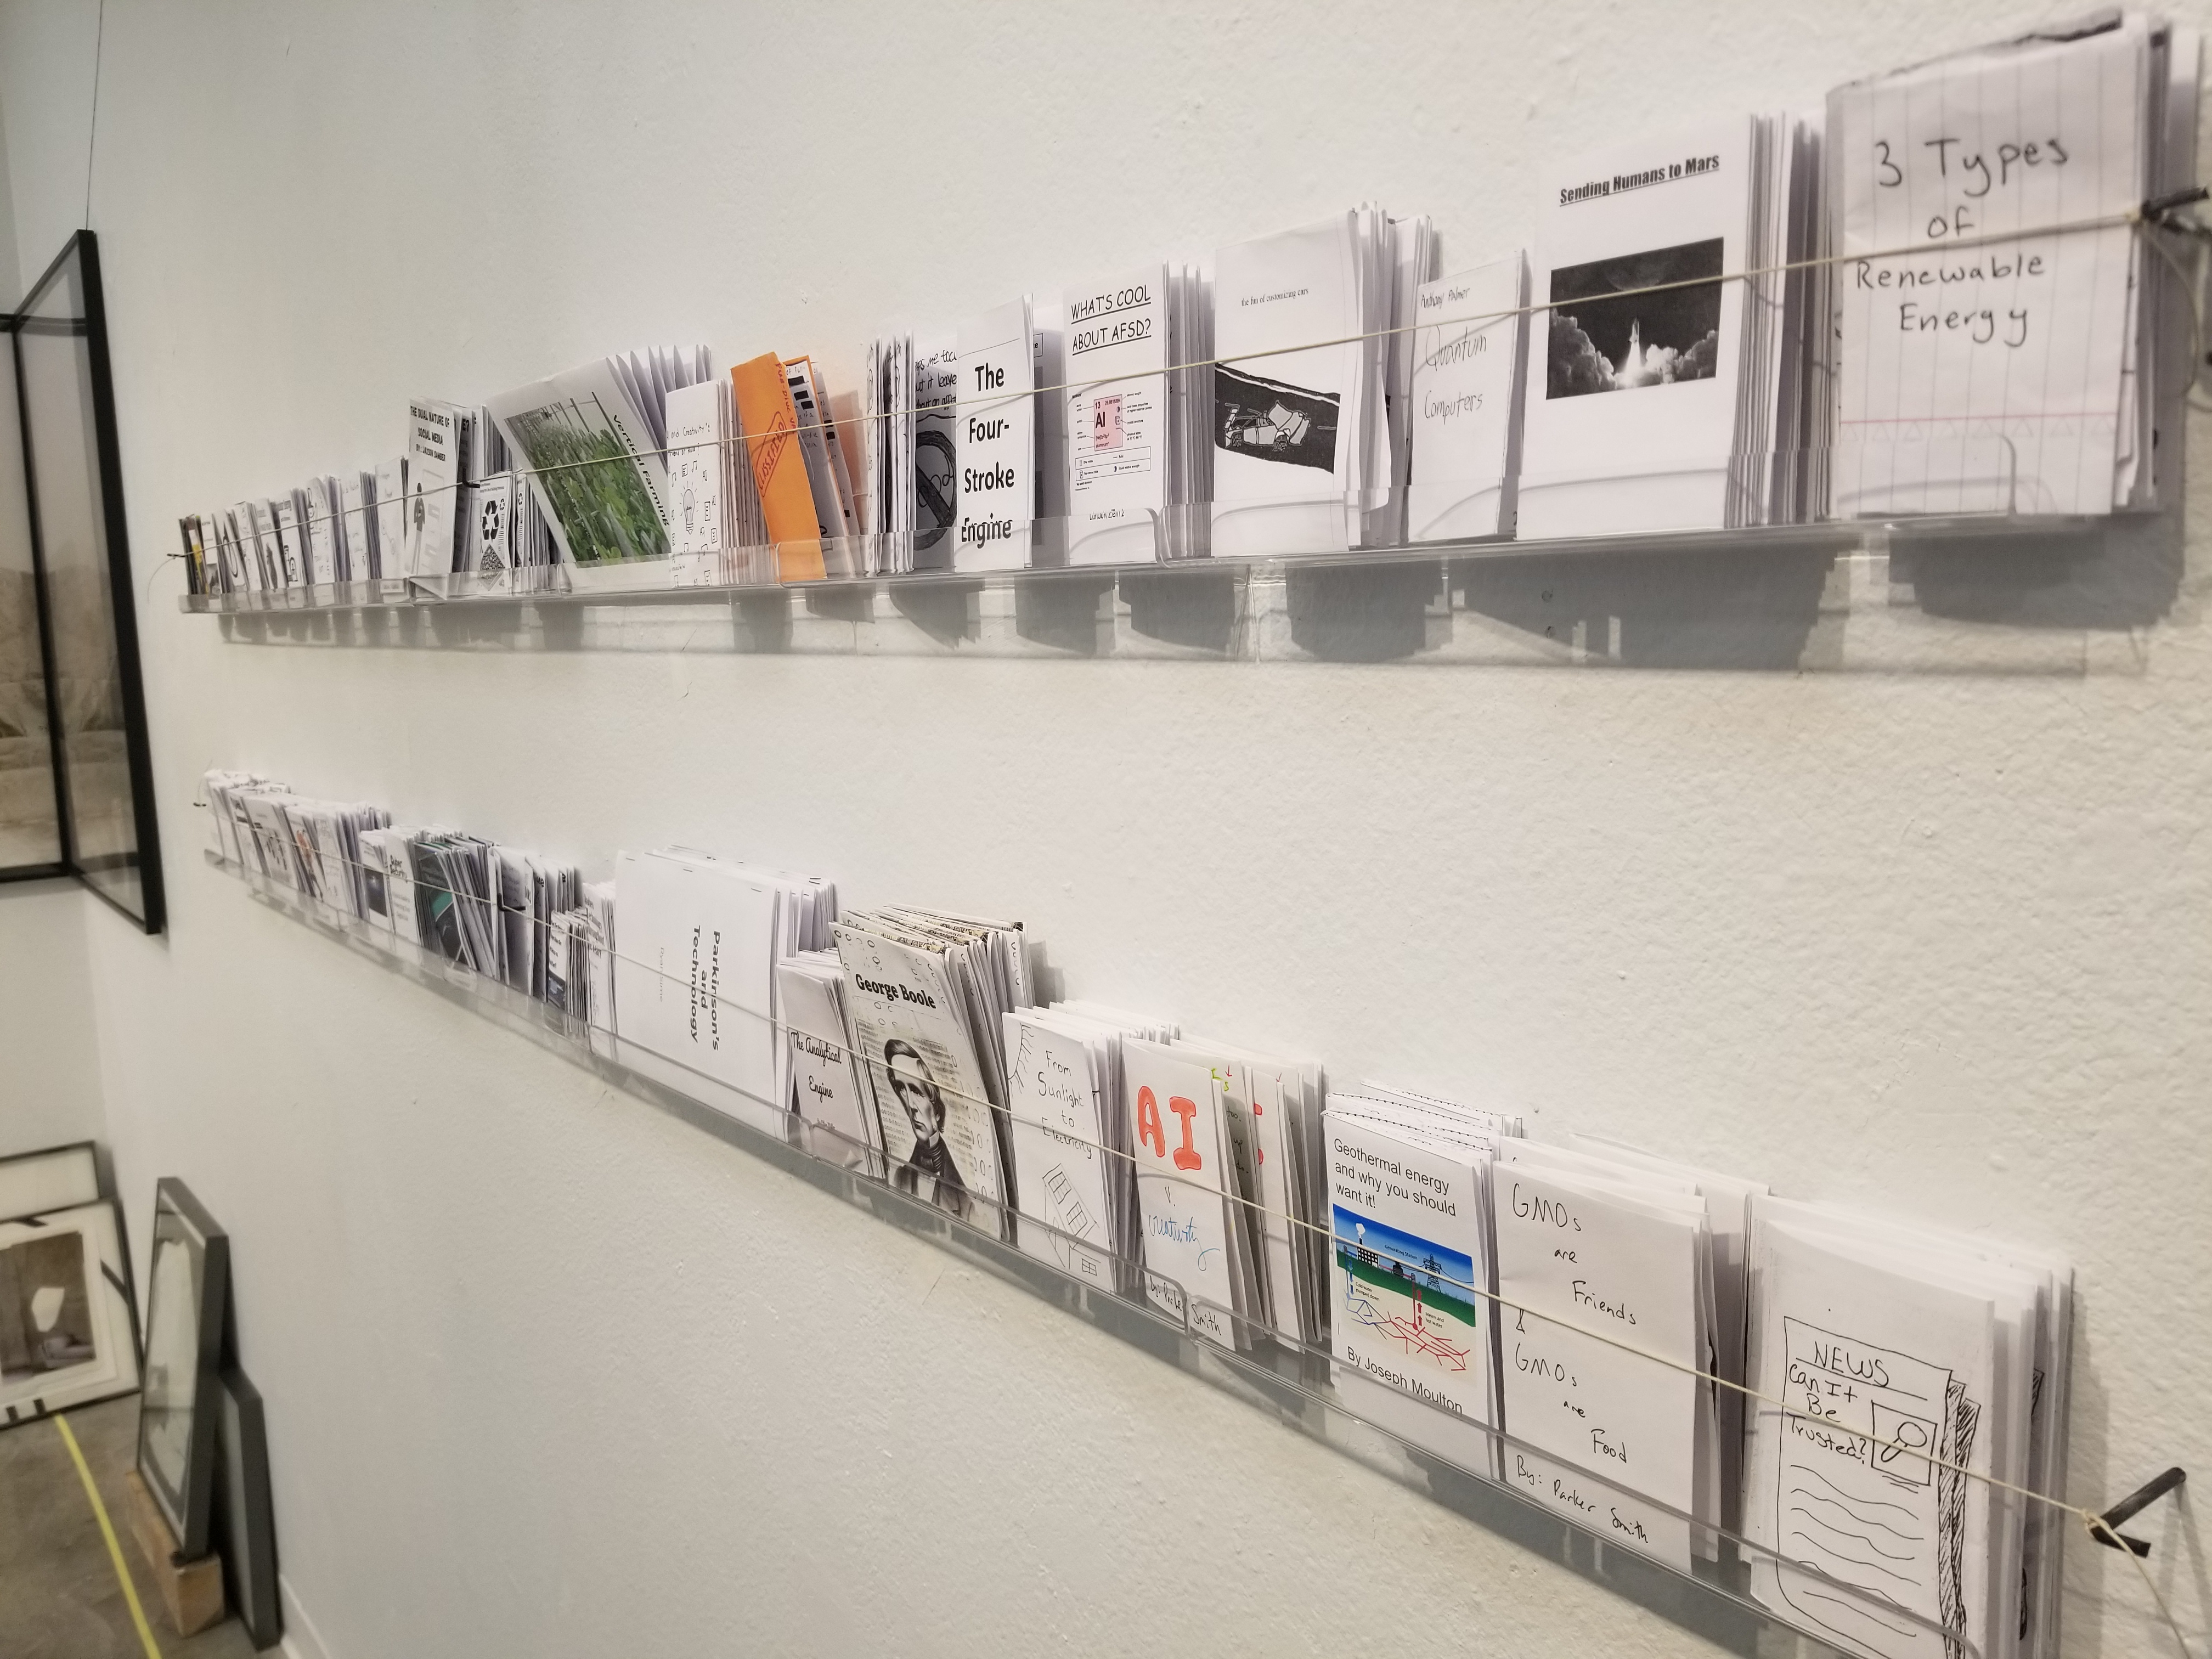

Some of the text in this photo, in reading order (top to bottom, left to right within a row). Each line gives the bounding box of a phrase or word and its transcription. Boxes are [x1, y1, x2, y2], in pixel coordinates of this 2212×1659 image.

[1560, 155, 1720, 205] Sending Humans to Mars
[1875, 138, 2068, 198] 3 Types
[1857, 254, 2045, 290] Renewable
[1071, 284, 1151, 320] WHAT'S COOL
[1260, 294, 1266, 303] of
[1266, 289, 1296, 301] customizing
[1073, 318, 1152, 352] ABOUT AFSD?
[1900, 302, 2028, 347] Energy
[1426, 325, 1487, 371] Quantum
[975, 363, 1005, 392] The
[1095, 401, 1101, 409] 13
[1425, 390, 1483, 425] Computers
[969, 417, 1009, 443] Four-
[613, 414, 670, 526] Vertical Farming
[964, 461, 1014, 493] Stroke
[961, 512, 1013, 549] Engine
[690, 925, 701, 1043] Technology
[711, 930, 721, 1051] Parkinson's
[855, 973, 936, 1009] George Boole
[791, 1031, 842, 1067] The Analytical
[1046, 1050, 1071, 1076] From
[809, 1075, 833, 1103] Engine
[1038, 1071, 1084, 1108] Sunlight
[1061, 1110, 1075, 1127] to
[1137, 1085, 1202, 1170] AI
[1041, 1116, 1092, 1159] Electricity
[1334, 1138, 1449, 1195] Geothermal energy
[1335, 1162, 1456, 1217] and why you should
[1335, 1182, 1376, 1209] want it!
[1513, 1183, 1582, 1232] GMOs
[1385, 1244, 1418, 1260] Generating Station
[1554, 1248, 1577, 1263] are
[1355, 1282, 1363, 1290] Cold
[1356, 1288, 1380, 1302] pumped down
[1572, 1280, 1637, 1325] Friends
[1191, 1304, 1222, 1336] Smith
[1425, 1311, 1437, 1320] Steam
[1347, 1346, 1463, 1416] By Joseph Moulton
[1515, 1342, 1578, 1387] GMOs
[1814, 1341, 1889, 1387] NEWS
[1564, 1401, 1586, 1418] are
[1807, 1393, 1841, 1423] Be
[1591, 1429, 1627, 1464] Food
[1786, 1412, 1866, 1465] Trusted?
[1516, 1455, 1649, 1543] By: Parker Smith
